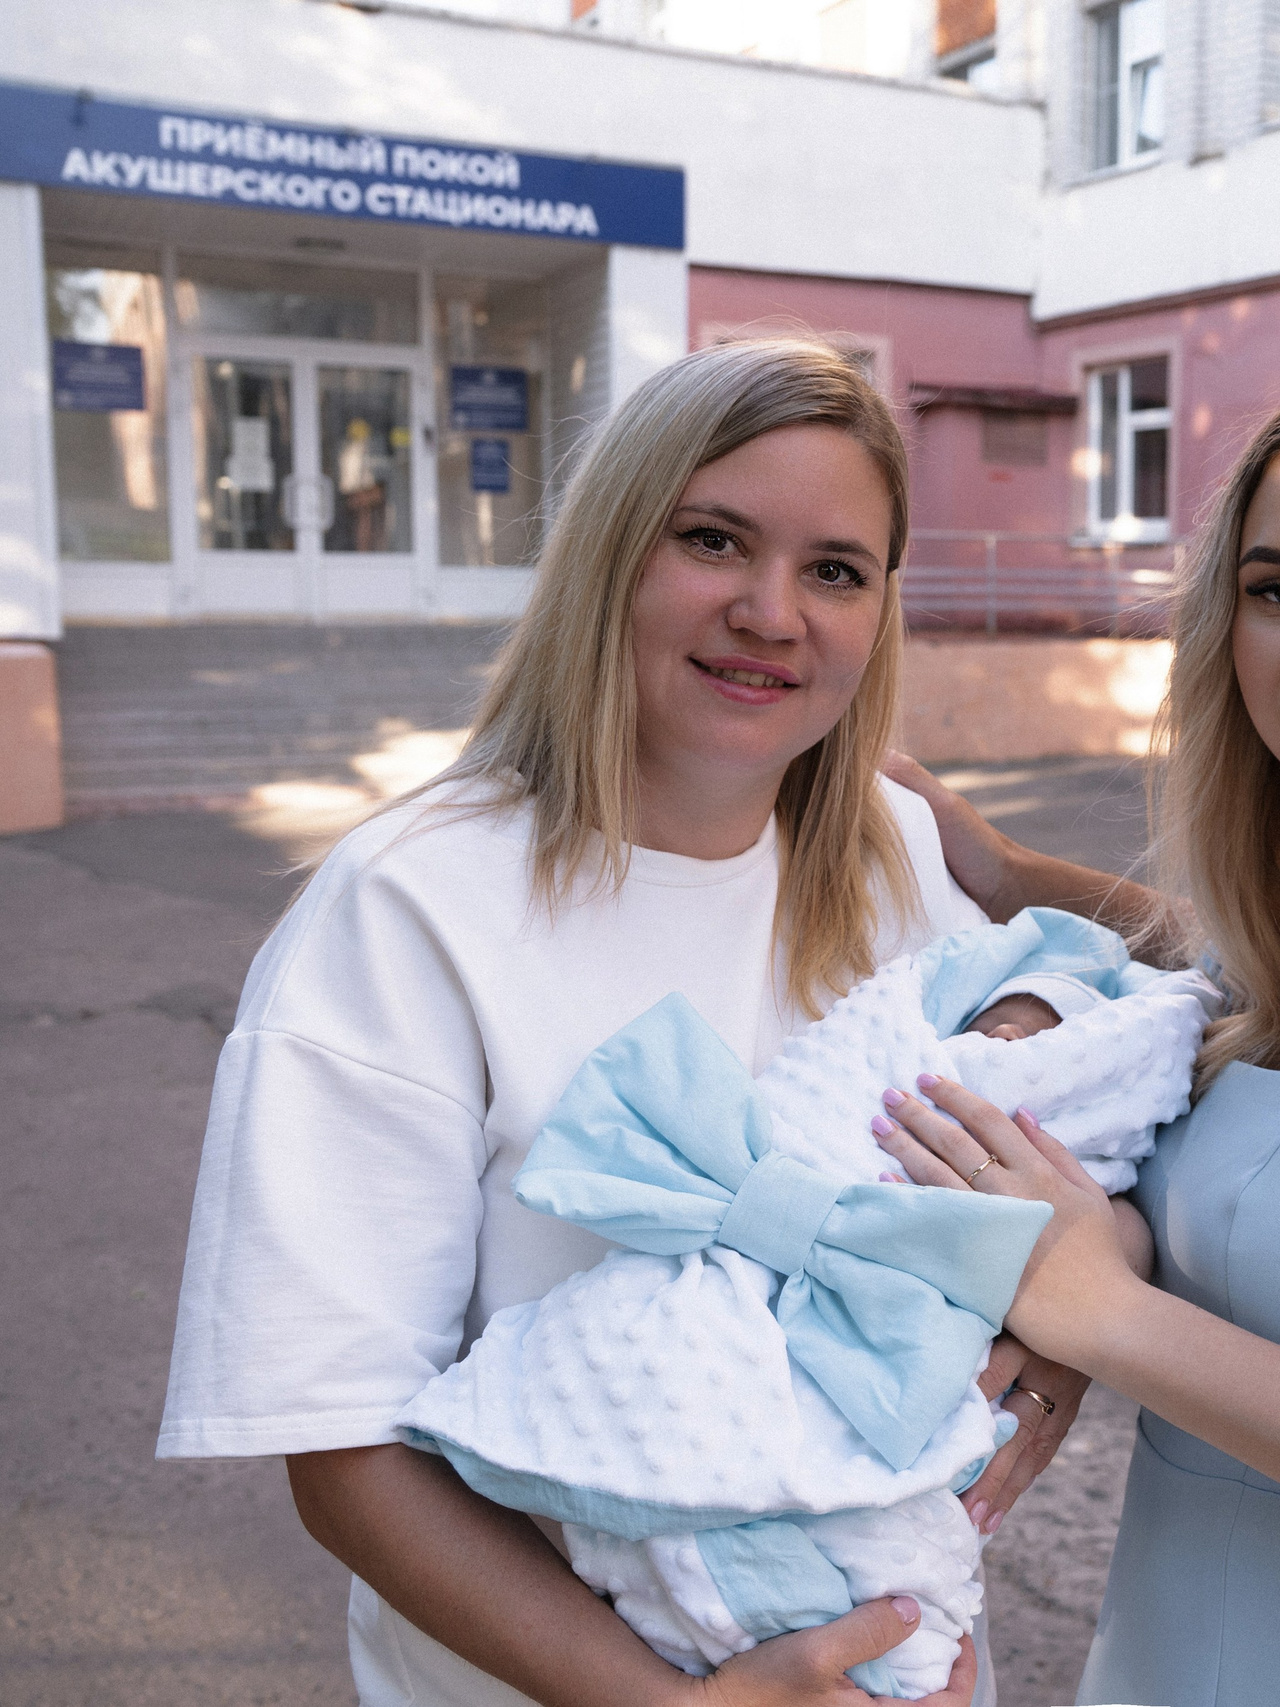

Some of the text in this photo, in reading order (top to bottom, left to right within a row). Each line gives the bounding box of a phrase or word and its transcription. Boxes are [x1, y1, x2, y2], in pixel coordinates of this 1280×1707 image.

[61, 148, 598, 235] АКУШЕРСКОГО СТАЦИОНАРА
[159, 115, 519, 188] ПРИЁМНЫЙ ПОКОЙ
